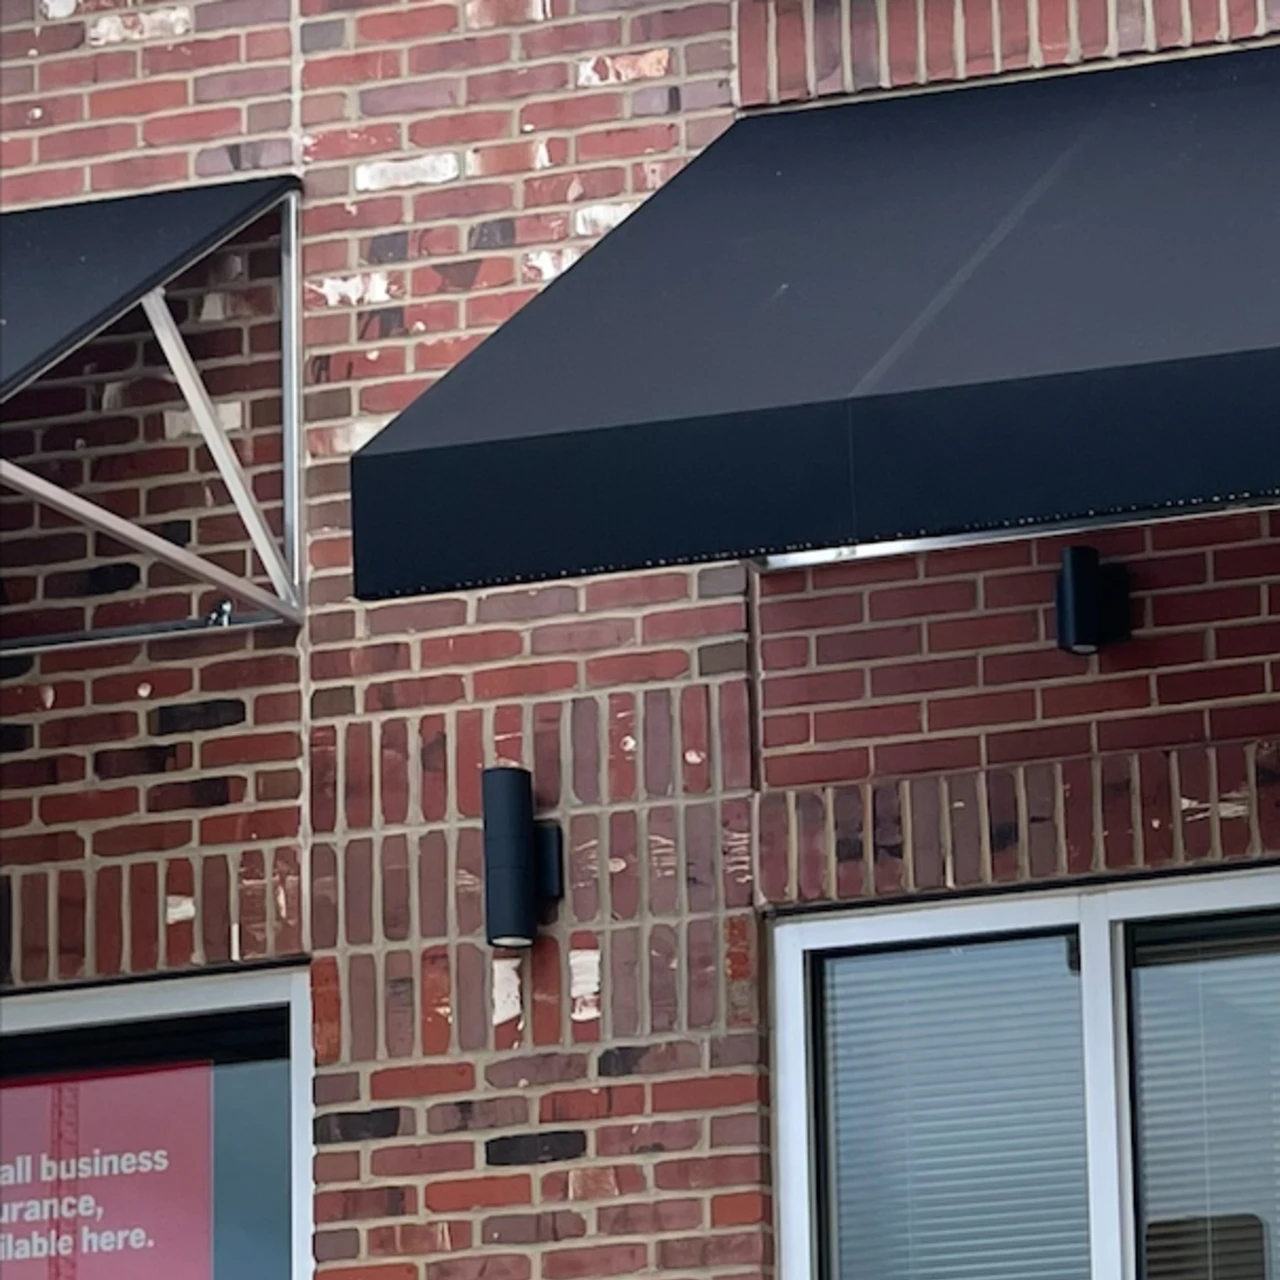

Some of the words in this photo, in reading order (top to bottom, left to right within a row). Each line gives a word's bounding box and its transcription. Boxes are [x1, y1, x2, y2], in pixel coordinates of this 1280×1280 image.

[0, 1155, 32, 1185] all
[40, 1149, 169, 1181] business
[81, 1226, 154, 1253] here.
